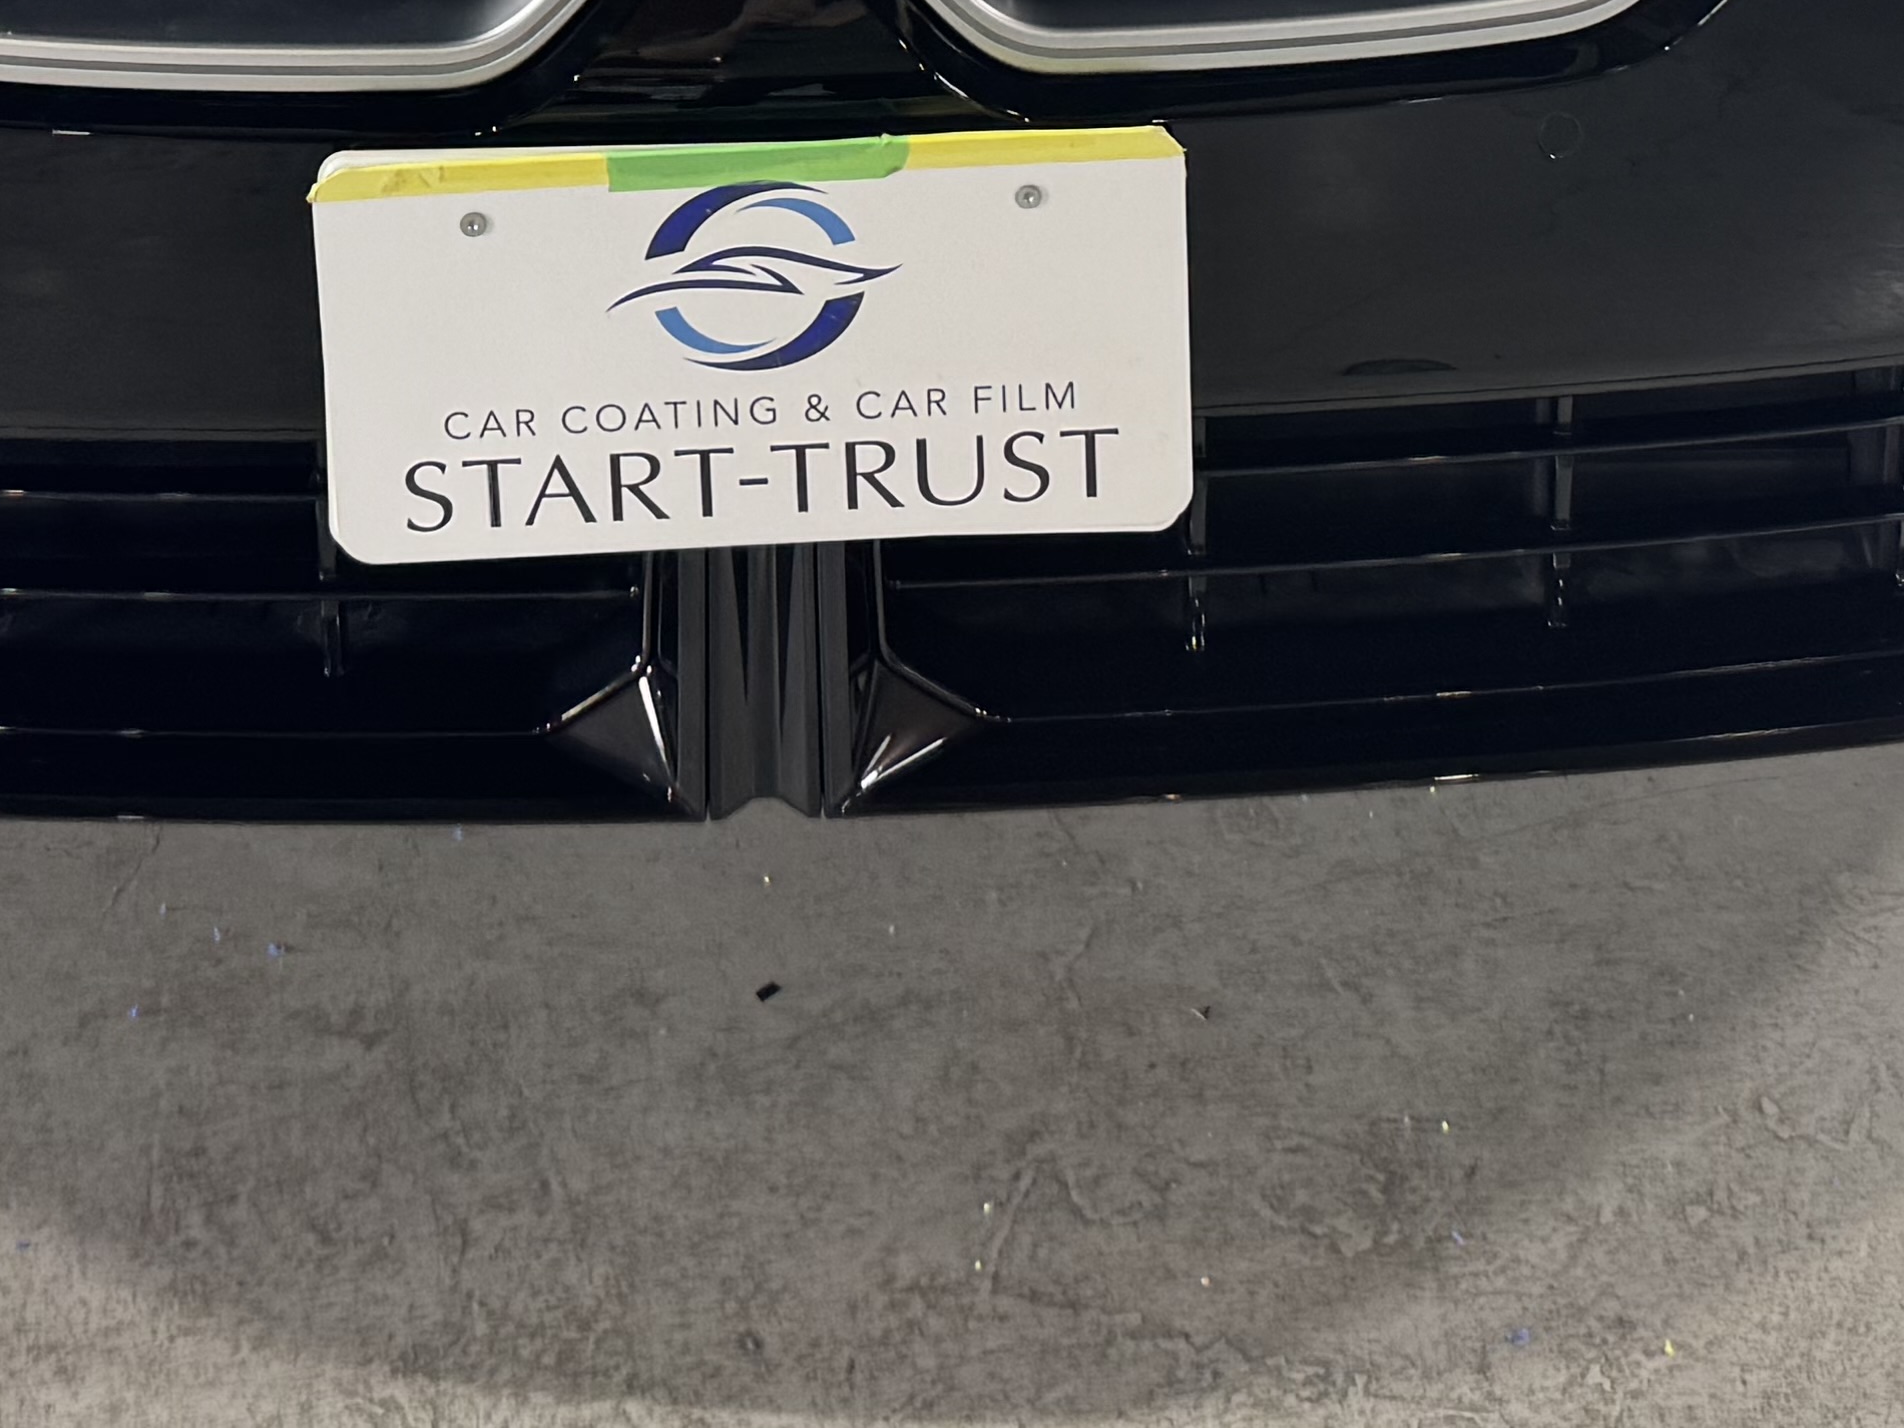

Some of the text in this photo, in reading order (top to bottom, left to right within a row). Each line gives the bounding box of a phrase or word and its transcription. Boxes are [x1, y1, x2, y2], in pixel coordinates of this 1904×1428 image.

[444, 381, 1075, 440] CAR COATING & CAR FILM
[405, 427, 1120, 533] START-TRUST
